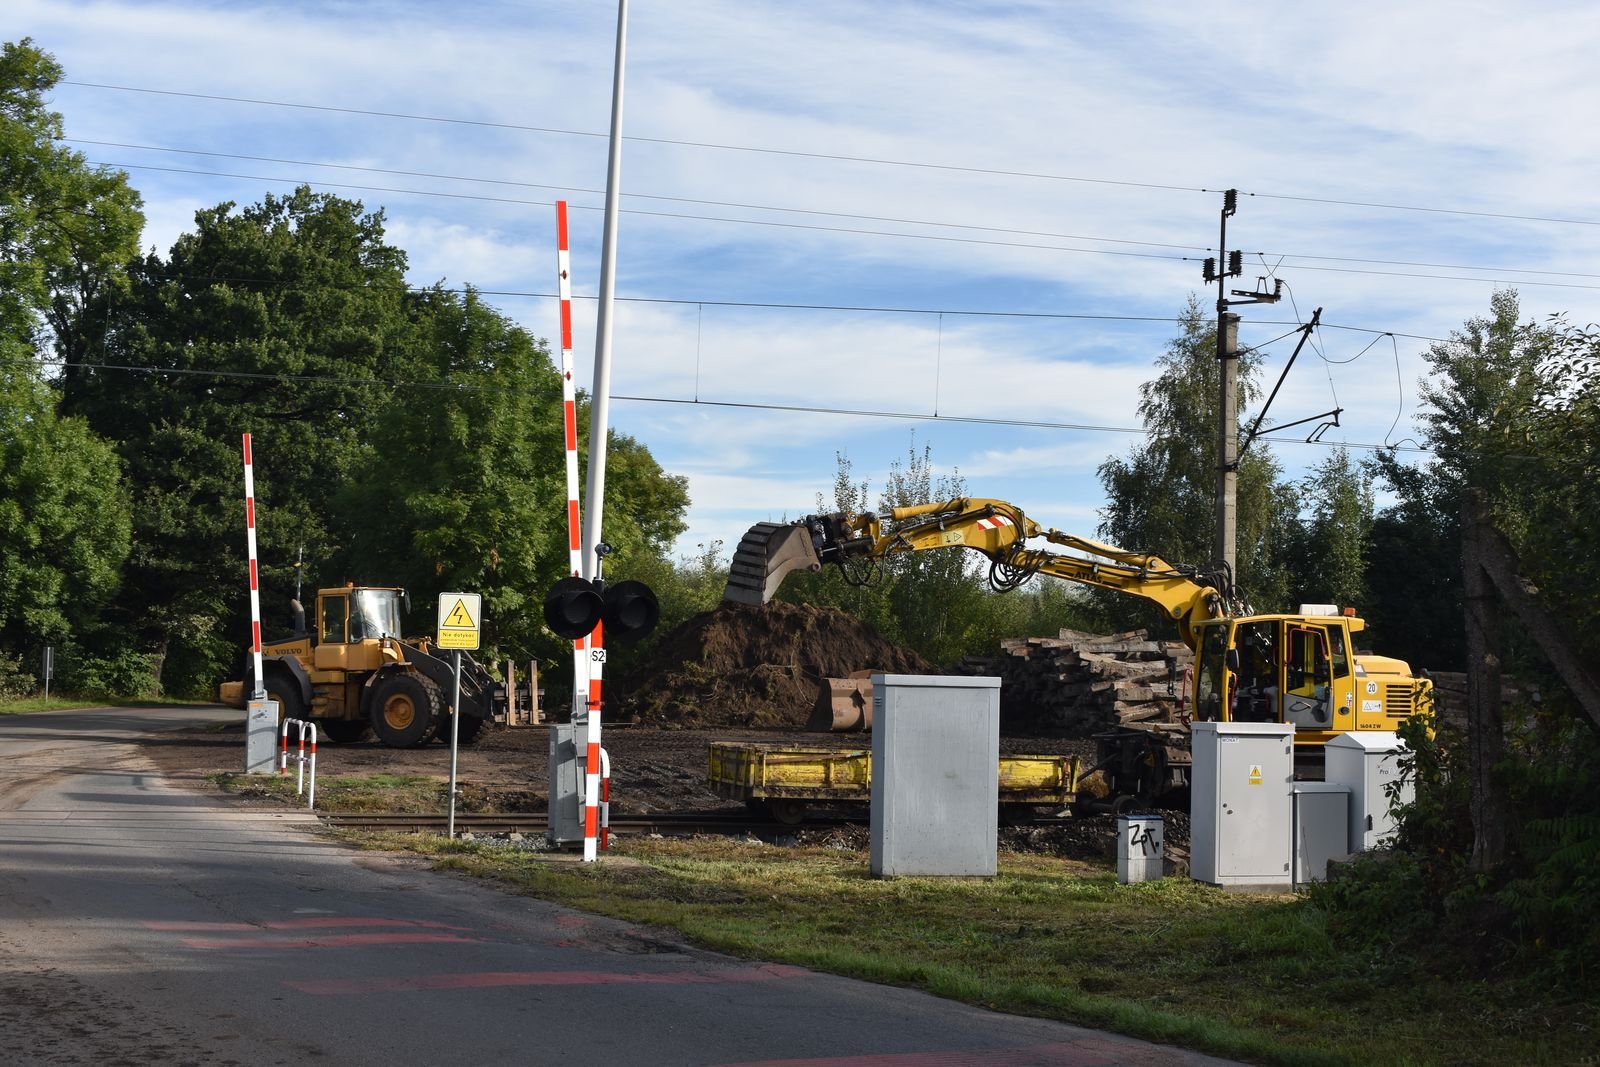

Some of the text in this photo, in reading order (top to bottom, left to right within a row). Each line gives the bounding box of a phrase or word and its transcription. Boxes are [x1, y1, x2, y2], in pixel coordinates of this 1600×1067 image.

[1073, 570, 1104, 584] ATLAS
[592, 650, 605, 662] S2
[1368, 683, 1376, 693] 20
